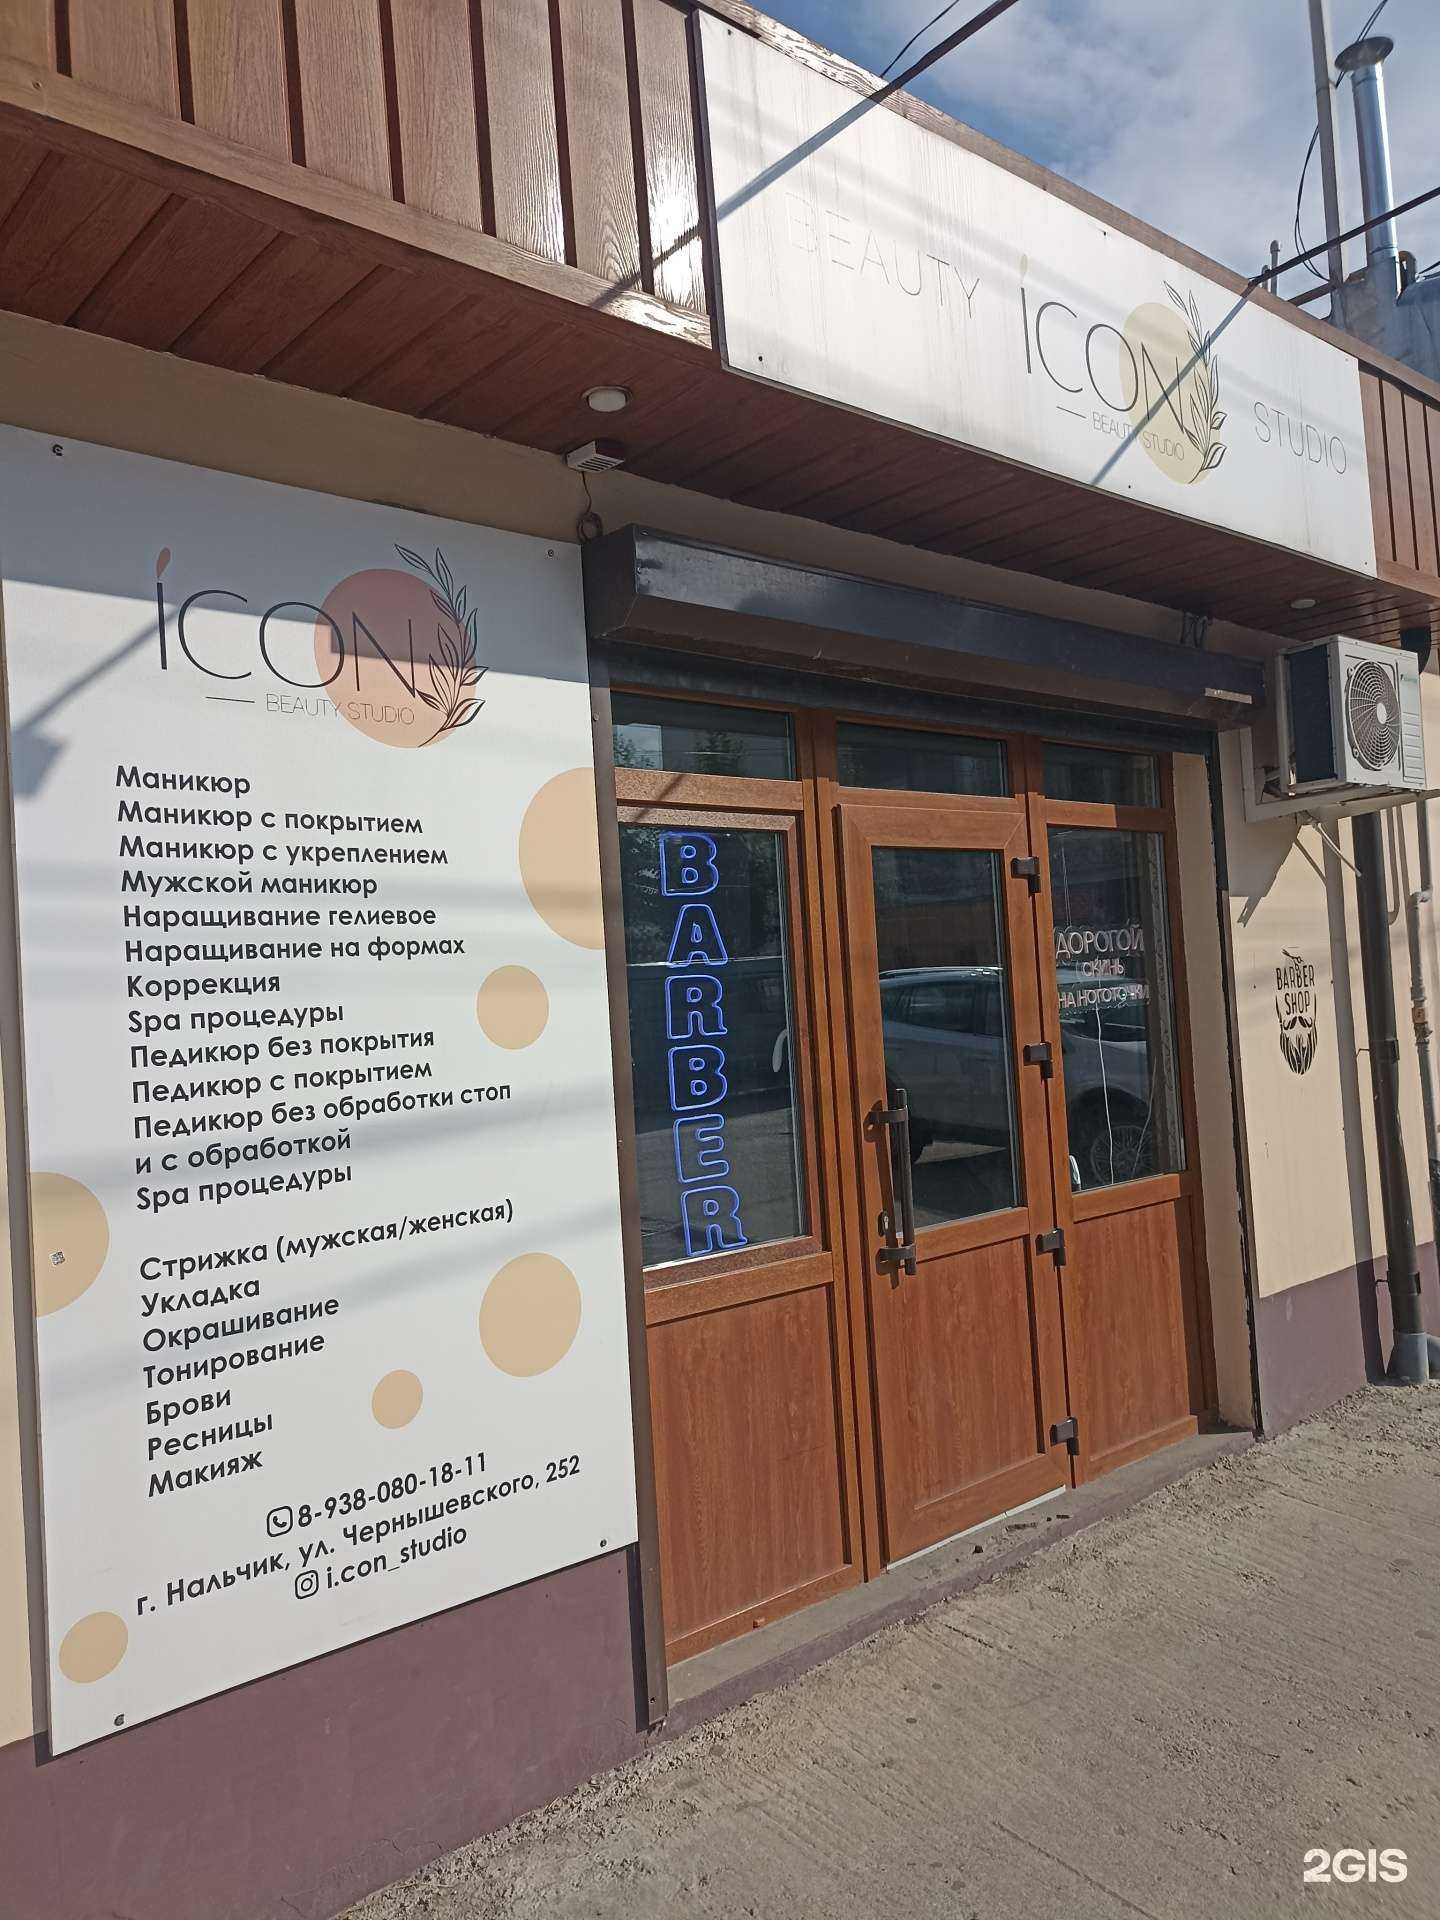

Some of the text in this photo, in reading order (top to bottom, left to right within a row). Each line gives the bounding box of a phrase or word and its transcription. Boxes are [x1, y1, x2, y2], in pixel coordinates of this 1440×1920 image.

[785, 192, 980, 319] BEAUTY
[1254, 401, 1347, 475] STUDIO
[1092, 411, 1185, 462] BEAUT STUDIO
[266, 693, 415, 725] BEAUTY STUDIO
[115, 765, 251, 799] Маникюр
[117, 800, 423, 836] Маникюр с покрытием
[119, 835, 449, 867] Маникюр с укреплением
[121, 870, 378, 899] Мужской маникюр
[123, 905, 437, 933] Наращивание гелиевое
[125, 936, 466, 967] Наращивание на формах
[1056, 924, 1145, 961] ДОРОГОЙ
[1083, 958, 1124, 977] СКИНЬ
[1276, 965, 1315, 990] BARBER
[127, 975, 280, 1002] Коррекция
[1058, 992, 1076, 1009] НА
[1285, 991, 1310, 1015] SHOP
[128, 1004, 344, 1038] Spa процедуры
[130, 1031, 434, 1068] Педикюр без покрытия
[659, 831, 749, 1257] BARBER
[132, 1062, 433, 1104] Педикюр с покрытием
[134, 1084, 511, 1139] Педикюр без обработки стоп
[135, 1127, 351, 1175] и с обработкой
[136, 1165, 352, 1214] Spa процедуры
[139, 1198, 513, 1281] Стрижка (мужская/женская)
[140, 1279, 260, 1318] Укладка
[142, 1298, 339, 1352] Окрашивание
[143, 1334, 325, 1388] Тонирование
[146, 1389, 231, 1427] Брови
[148, 1413, 273, 1461] Ресницы
[148, 1450, 263, 1498] Макияж
[298, 1452, 486, 1528] 8-938-080-18-11
[137, 1454, 580, 1616] г. Нальчик, ул. Чернышевского, 252
[326, 1528, 467, 1589] i.con_studio
